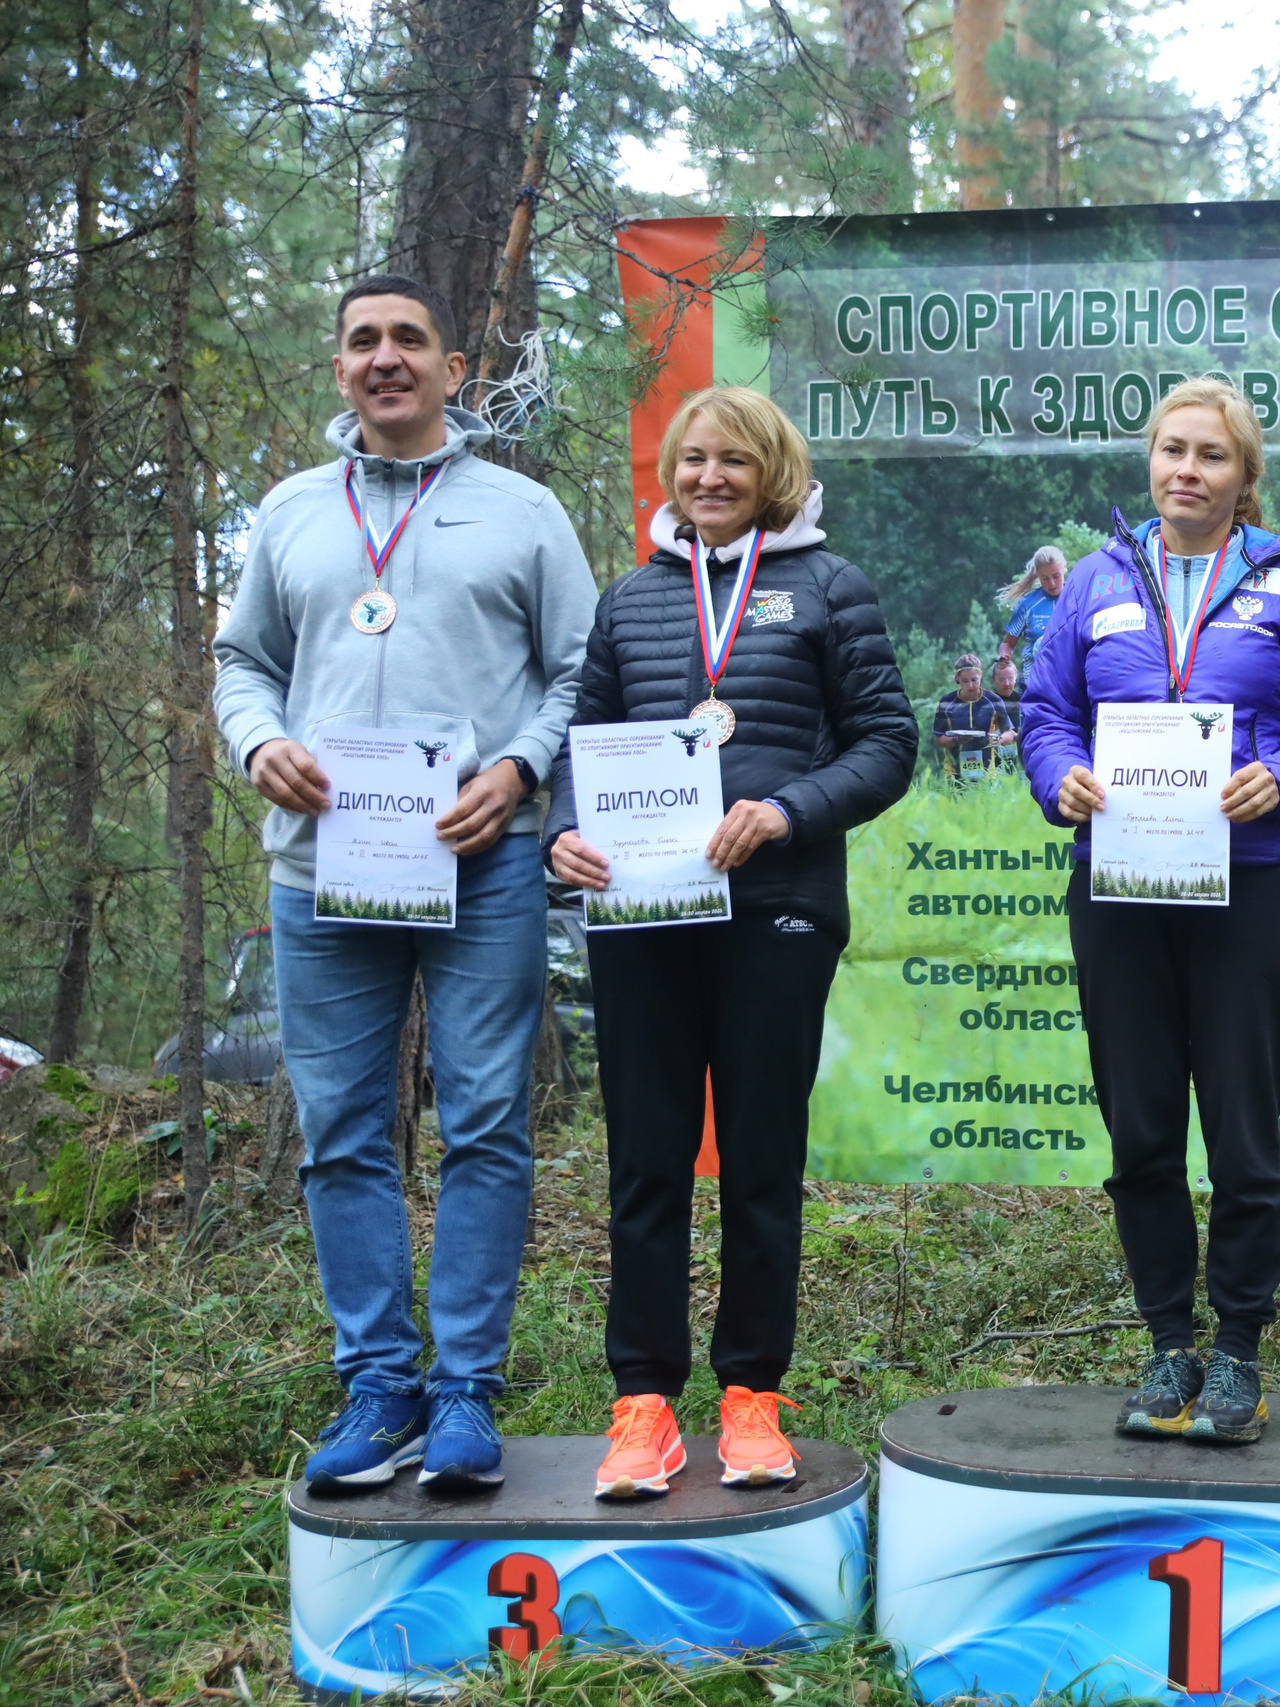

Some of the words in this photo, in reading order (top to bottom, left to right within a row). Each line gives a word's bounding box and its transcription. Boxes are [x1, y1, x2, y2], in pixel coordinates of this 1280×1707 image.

[838, 285, 1248, 356] СПОРТИВНОЕ
[808, 377, 959, 440] ПУТЬ
[979, 375, 1012, 438] К
[756, 610, 796, 622] GAMES
[1208, 622, 1274, 637] РОСАВТОДОР
[1111, 768, 1208, 788] ДИПЛОМ
[337, 792, 435, 814] ДИПЛОМ
[596, 787, 699, 813] ДИПЛОМ
[907, 894, 1070, 916] автоном
[959, 1001, 1088, 1031] област
[884, 1074, 1100, 1106] Челябинск
[929, 1119, 1086, 1151] область
[487, 1552, 563, 1670] 3
[1148, 1536, 1224, 1694] 1
